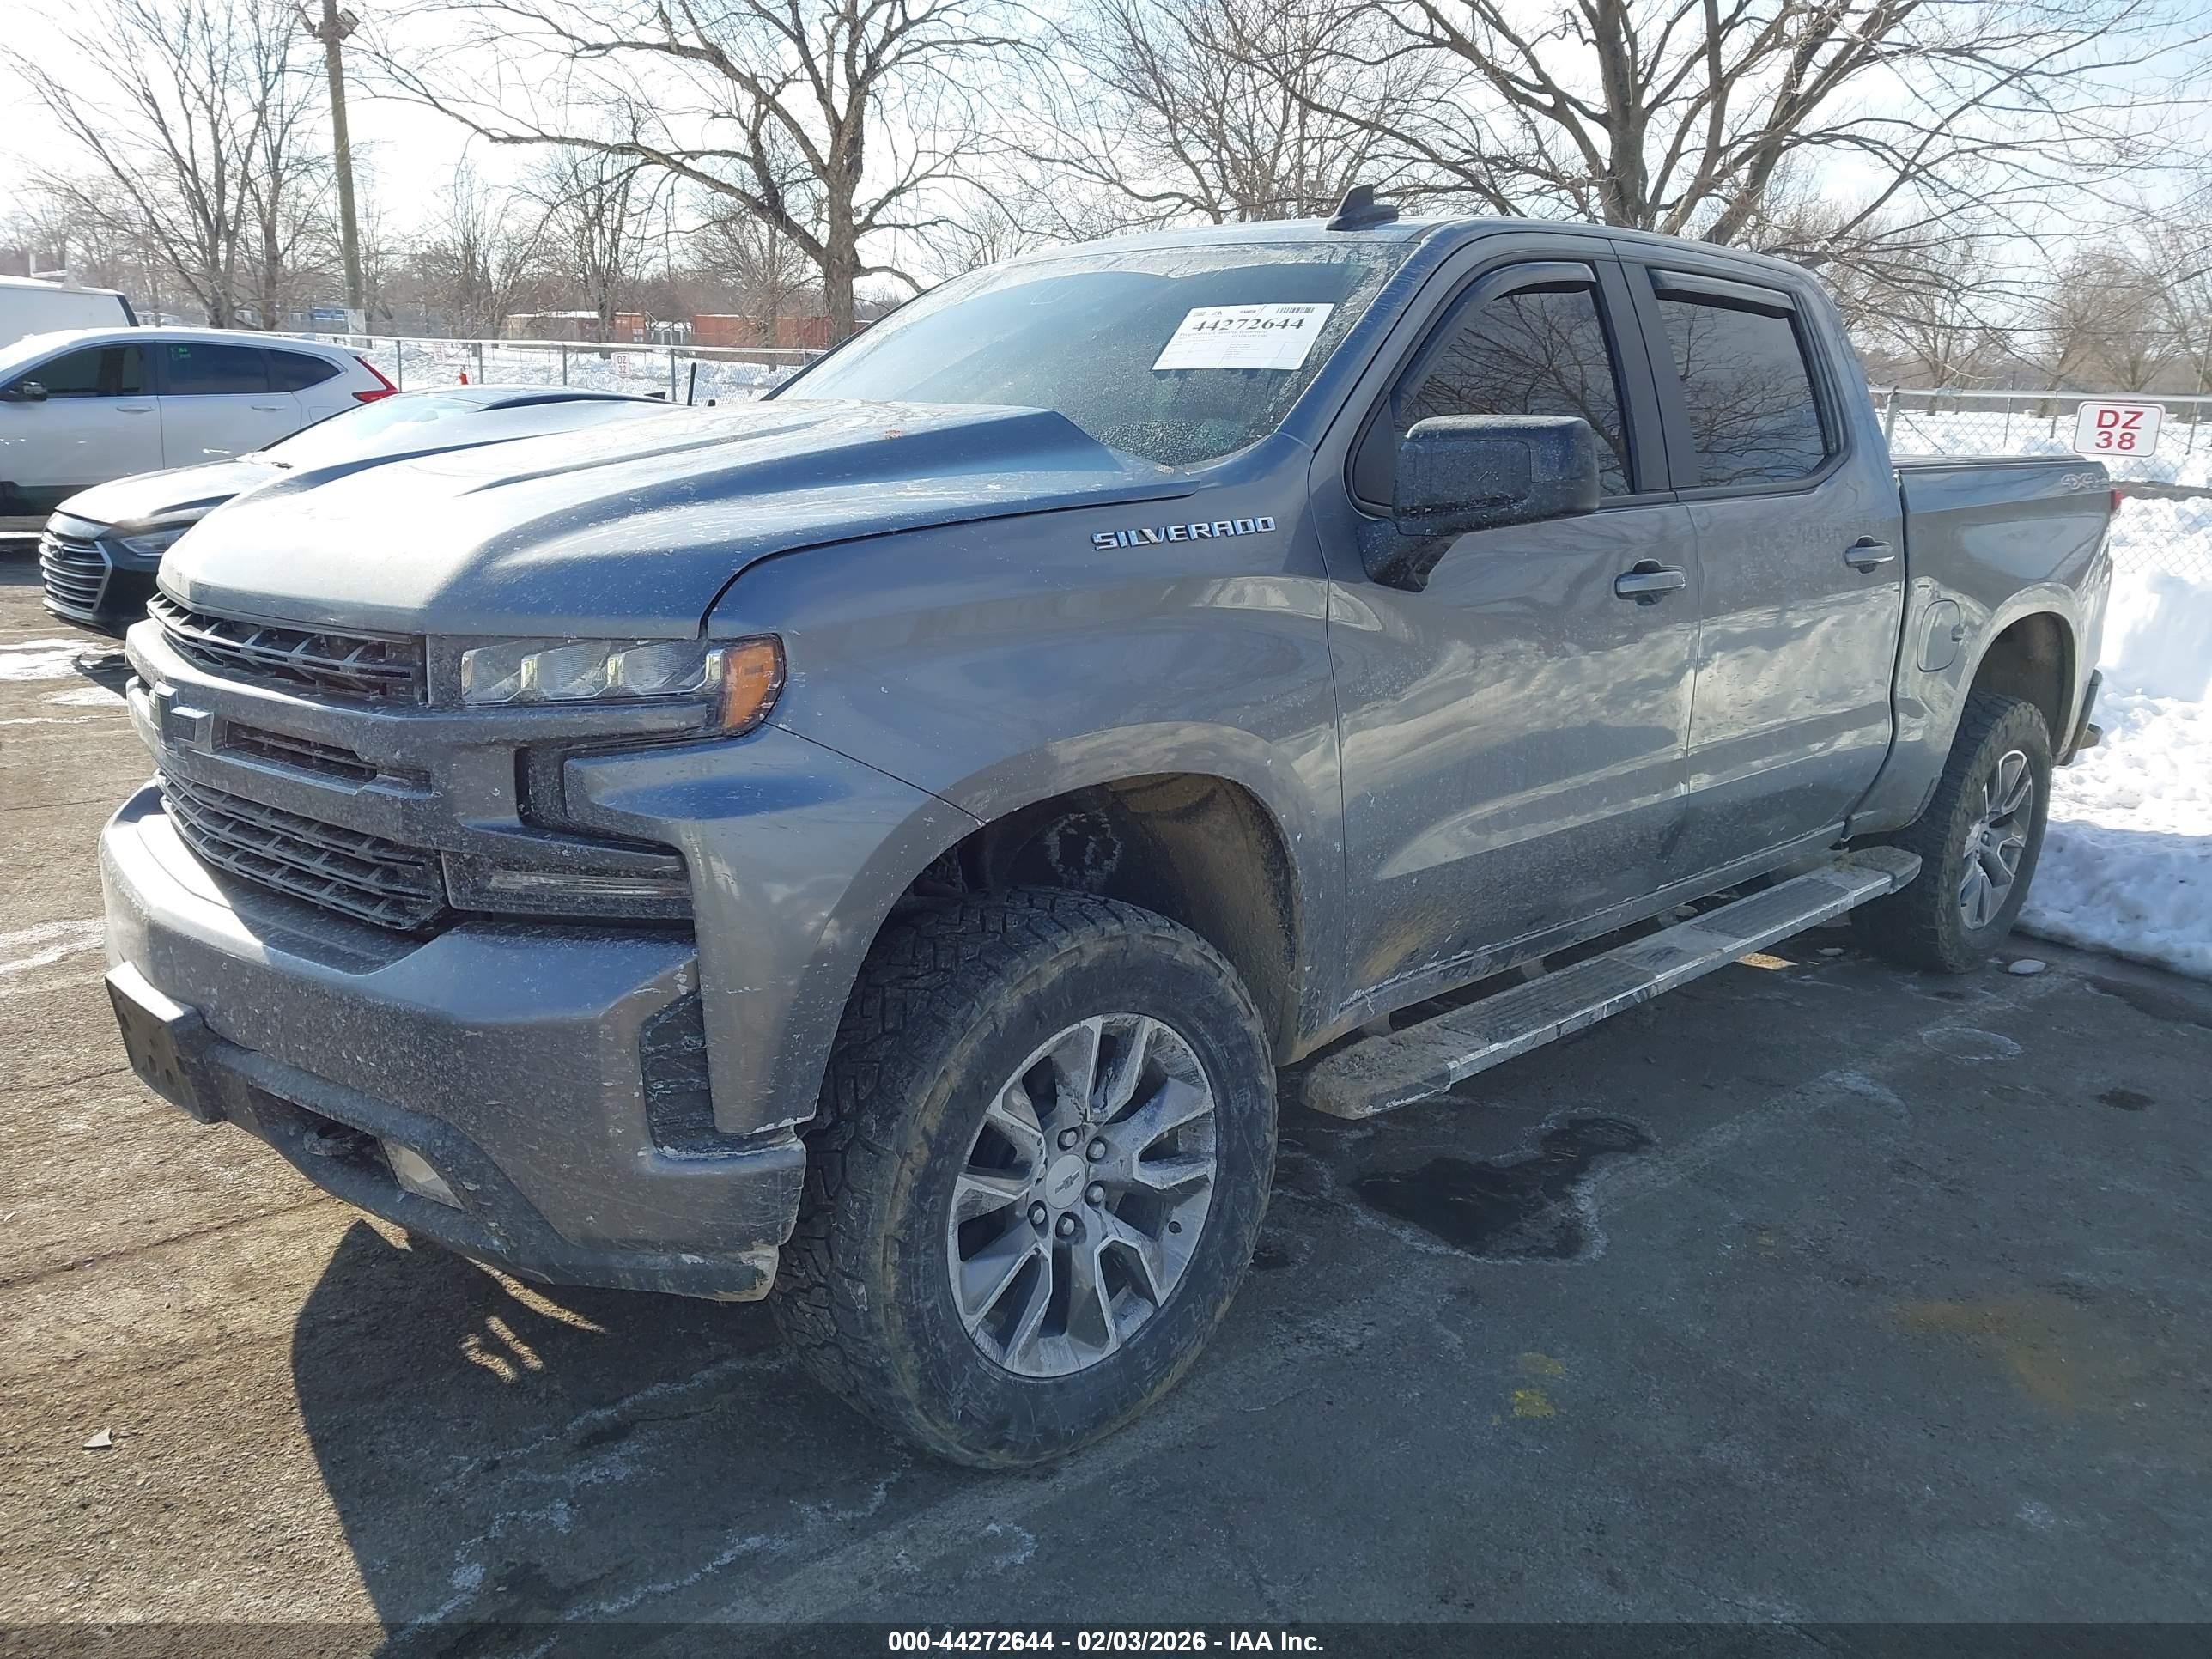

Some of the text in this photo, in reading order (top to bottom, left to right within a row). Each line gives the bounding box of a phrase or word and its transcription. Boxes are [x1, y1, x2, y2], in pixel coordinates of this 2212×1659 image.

[1191, 317, 1305, 332] 44272644
[2095, 409, 2144, 430] DZ
[2095, 430, 2136, 451] 38
[1091, 515, 1278, 551] SILVERADO
